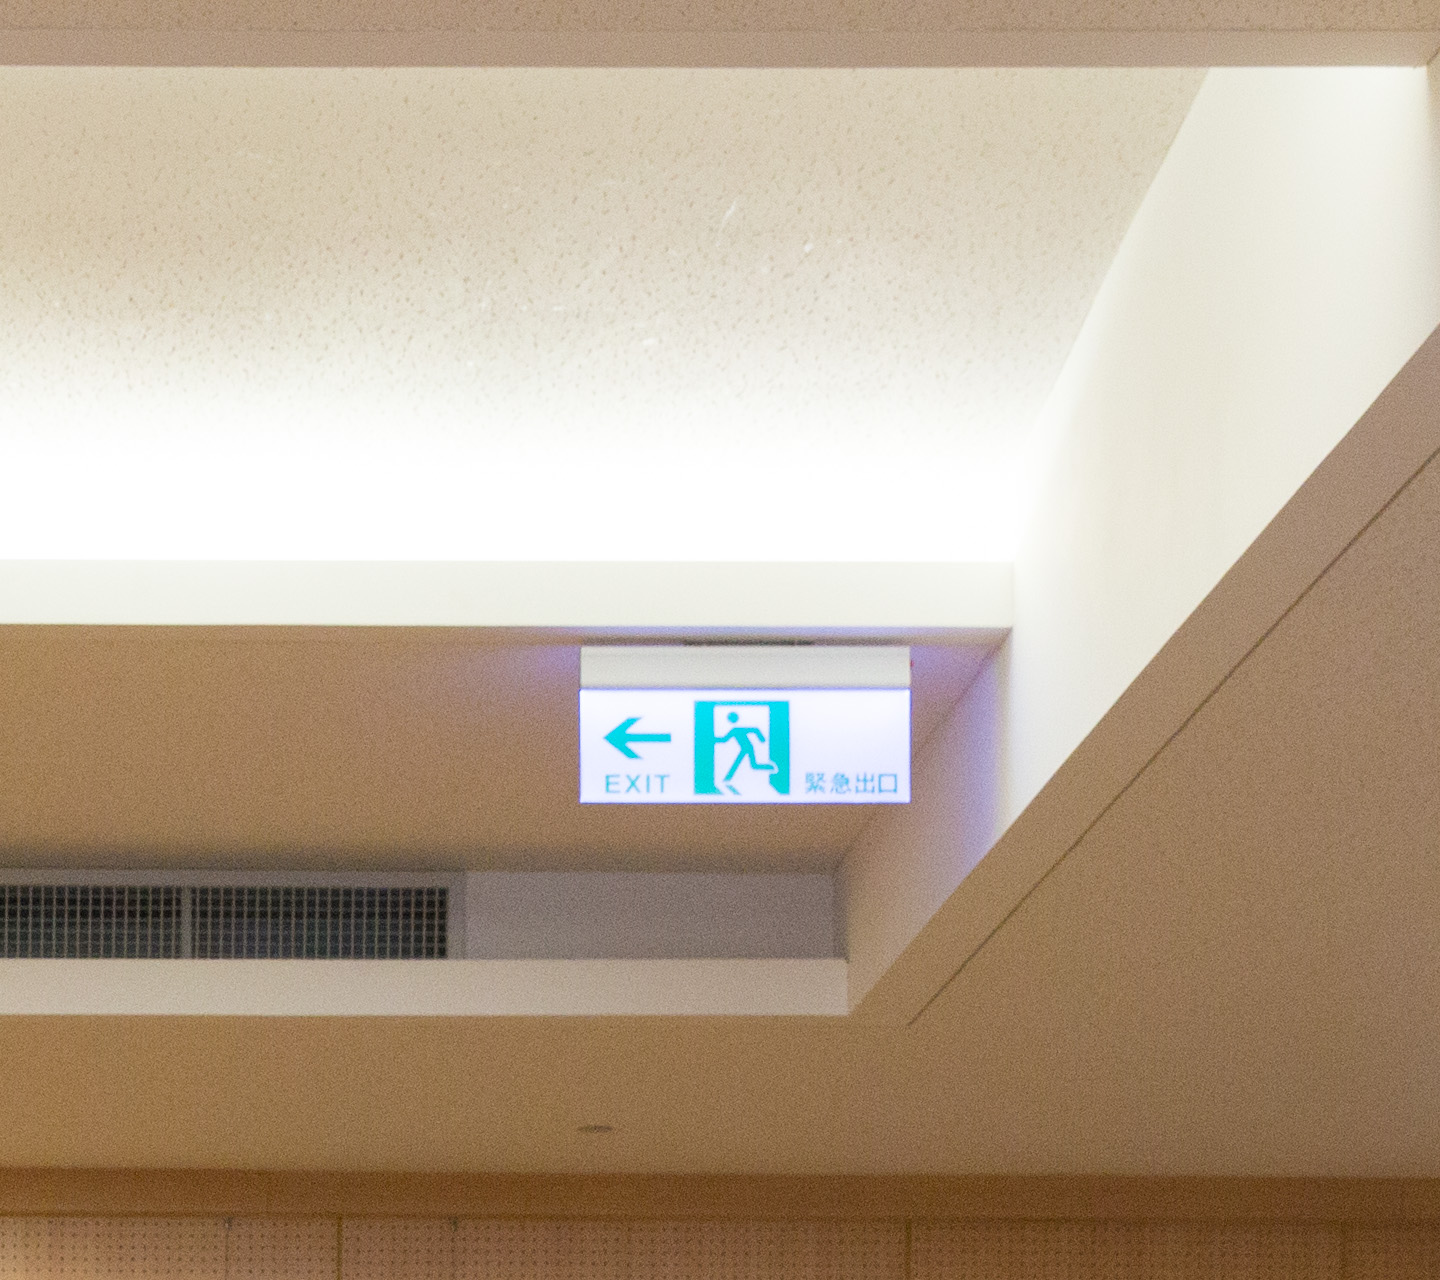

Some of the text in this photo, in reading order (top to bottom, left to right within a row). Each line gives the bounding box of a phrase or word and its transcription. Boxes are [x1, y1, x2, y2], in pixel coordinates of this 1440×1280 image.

[605, 774, 671, 794] EXIT
[805, 771, 898, 795] 緊急出口
